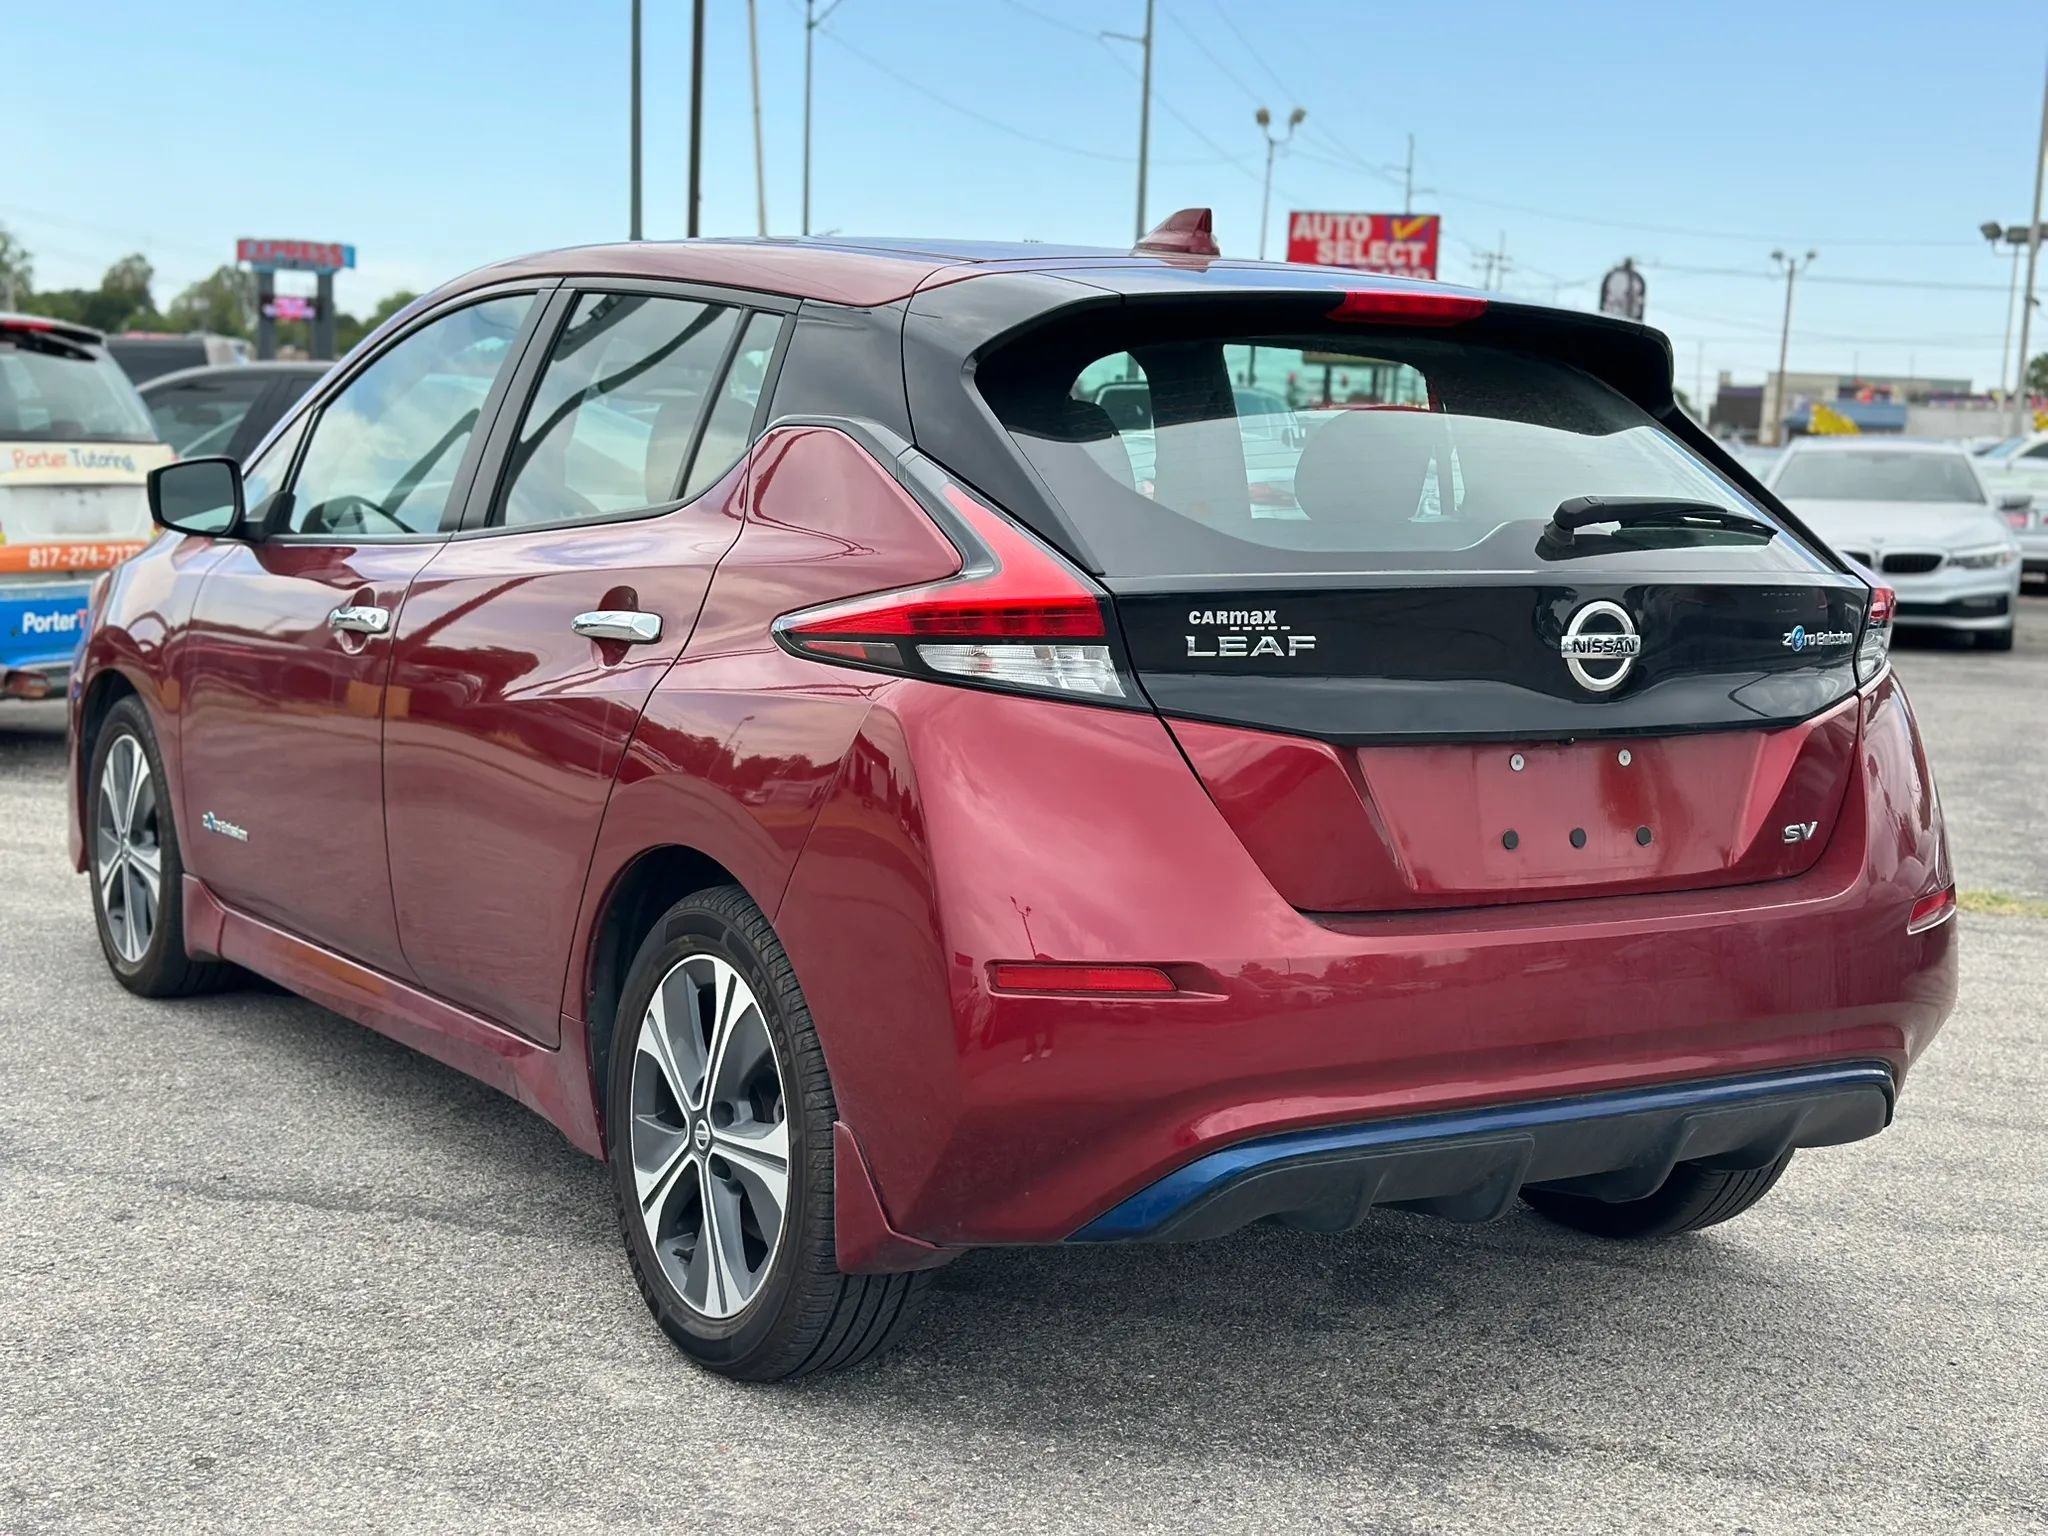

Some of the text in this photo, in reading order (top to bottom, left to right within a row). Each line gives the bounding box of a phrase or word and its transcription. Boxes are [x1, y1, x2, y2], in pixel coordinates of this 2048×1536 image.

[1293, 213, 1372, 241] AUTO
[238, 239, 344, 268] EXPRESS
[1315, 239, 1428, 267] SELECT
[12, 448, 136, 472] Porter Tutoring
[1184, 635, 1317, 657] LEAF
[1572, 640, 1635, 653] NISSAN
[1784, 821, 1818, 844] SV
